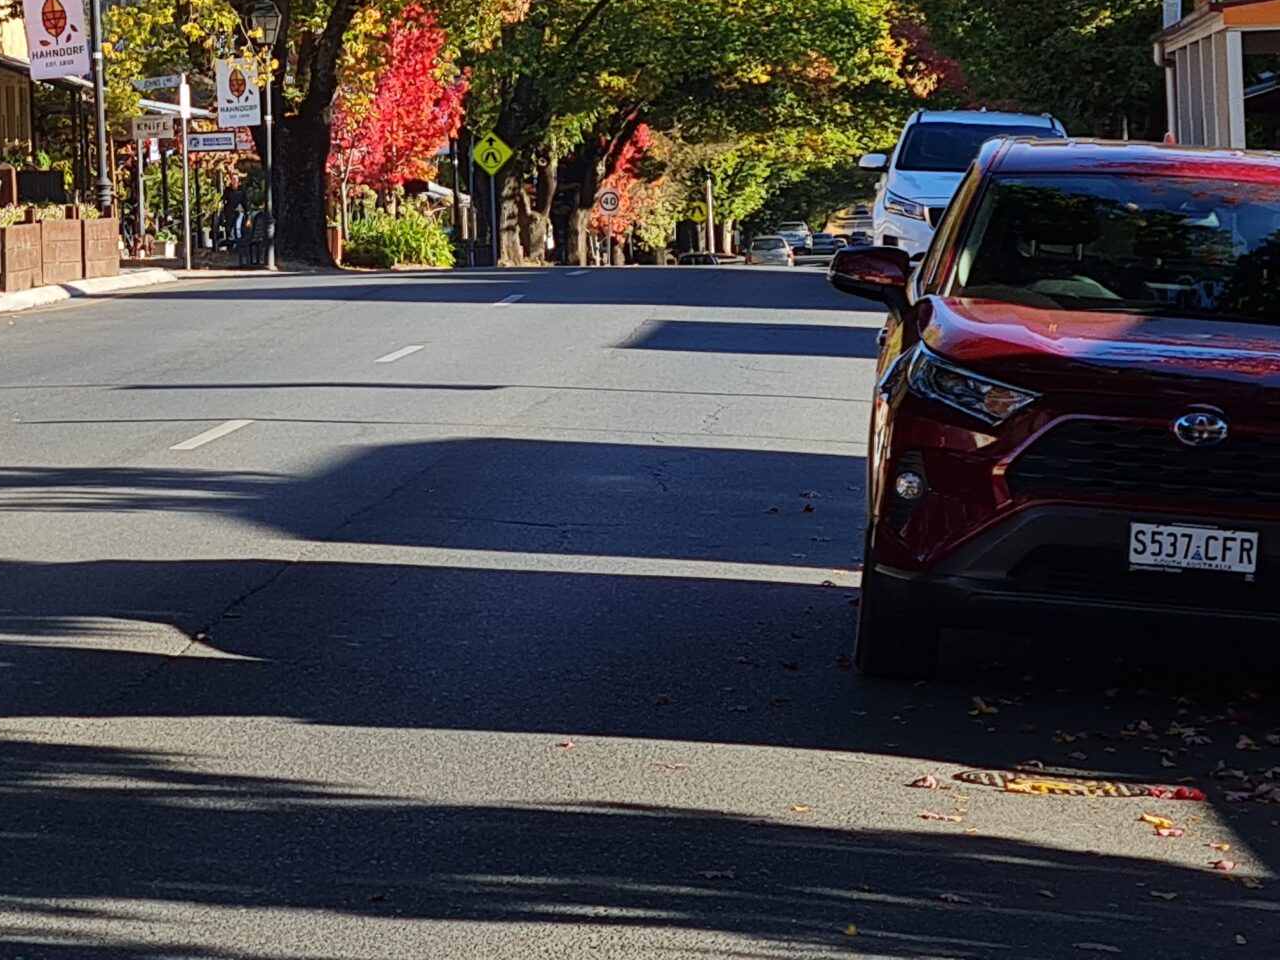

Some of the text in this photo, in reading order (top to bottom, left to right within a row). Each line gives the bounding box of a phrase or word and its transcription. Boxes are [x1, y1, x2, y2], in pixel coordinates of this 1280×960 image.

[32, 45, 85, 60] HAHNDORF
[136, 121, 169, 131] KNIFE
[603, 197, 616, 206] 40
[1132, 529, 1255, 564] S537 CFR
